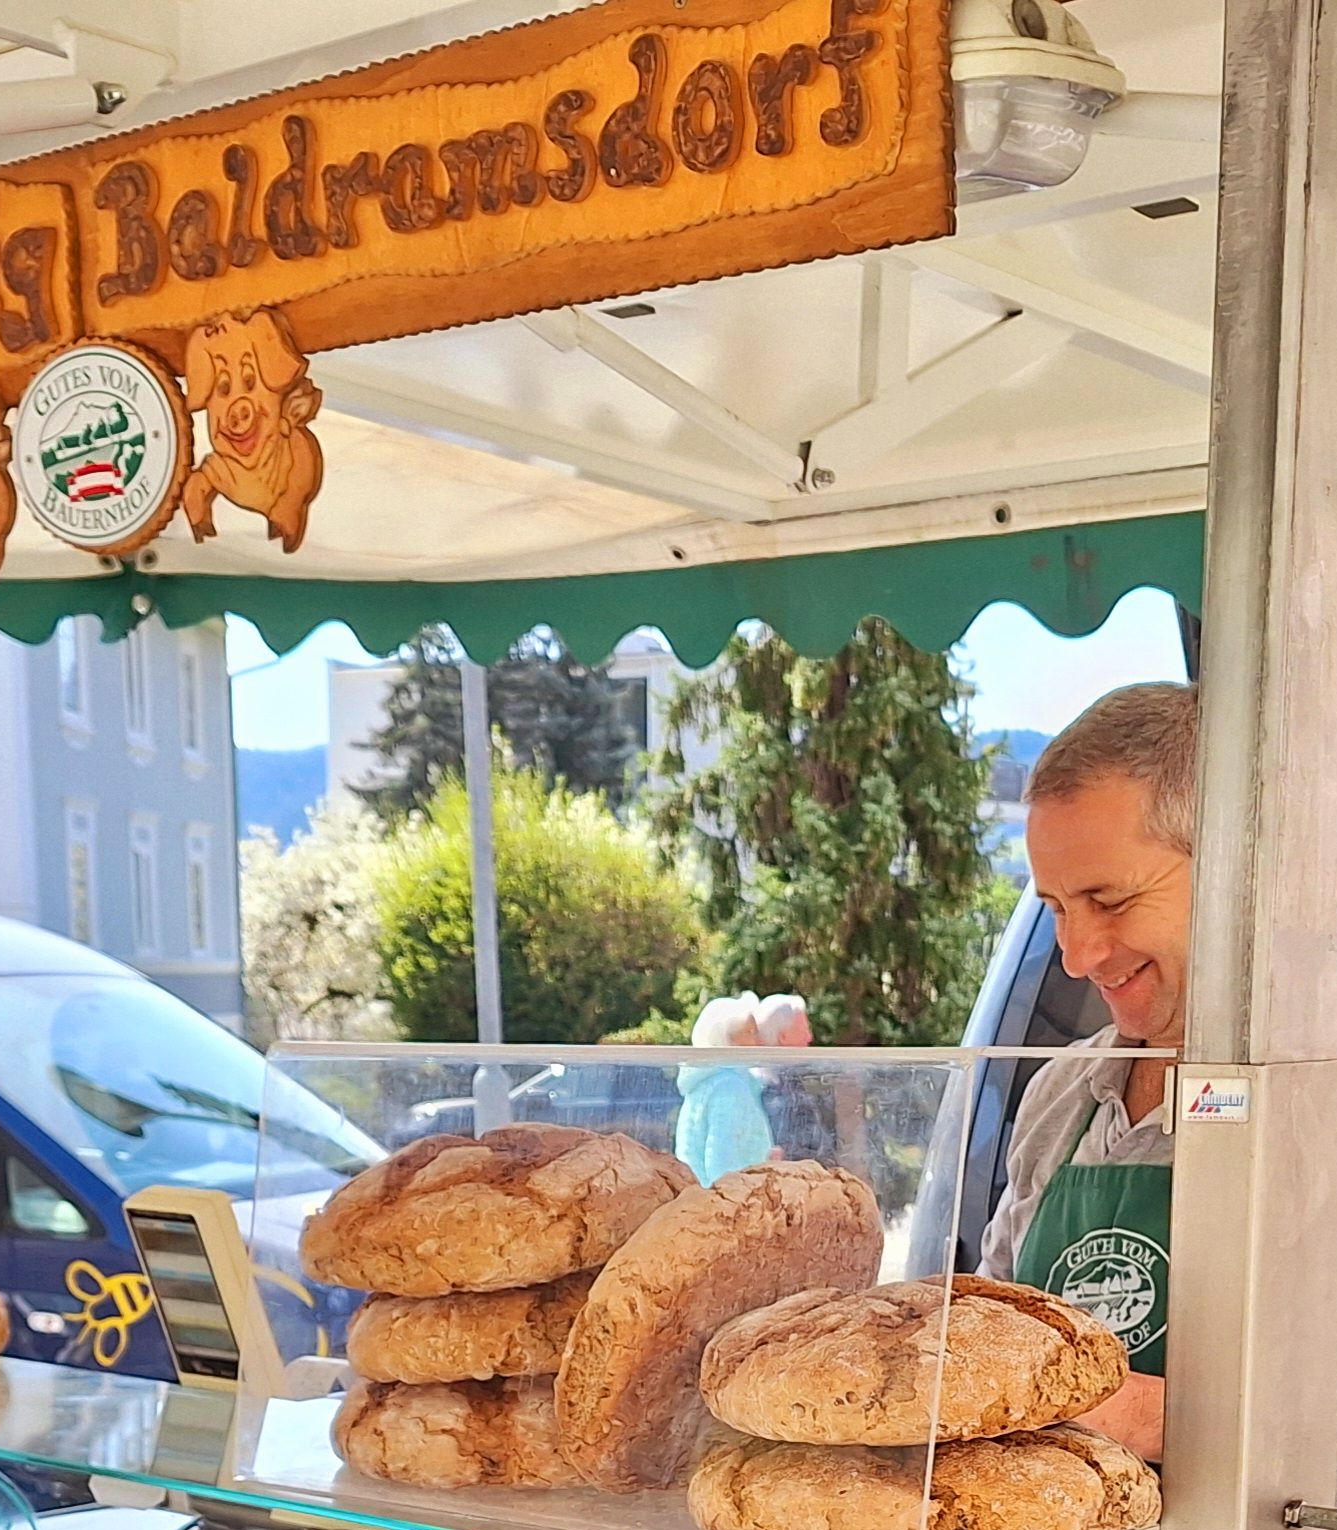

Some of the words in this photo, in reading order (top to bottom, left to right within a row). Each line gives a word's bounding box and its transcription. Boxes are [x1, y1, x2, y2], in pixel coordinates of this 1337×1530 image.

[95, 0, 890, 307] Baldramsdorf
[33, 365, 92, 418] GUTES
[98, 363, 142, 401] VOM
[41, 475, 153, 531] BAUERNHOF
[1121, 1238, 1159, 1271] VOM
